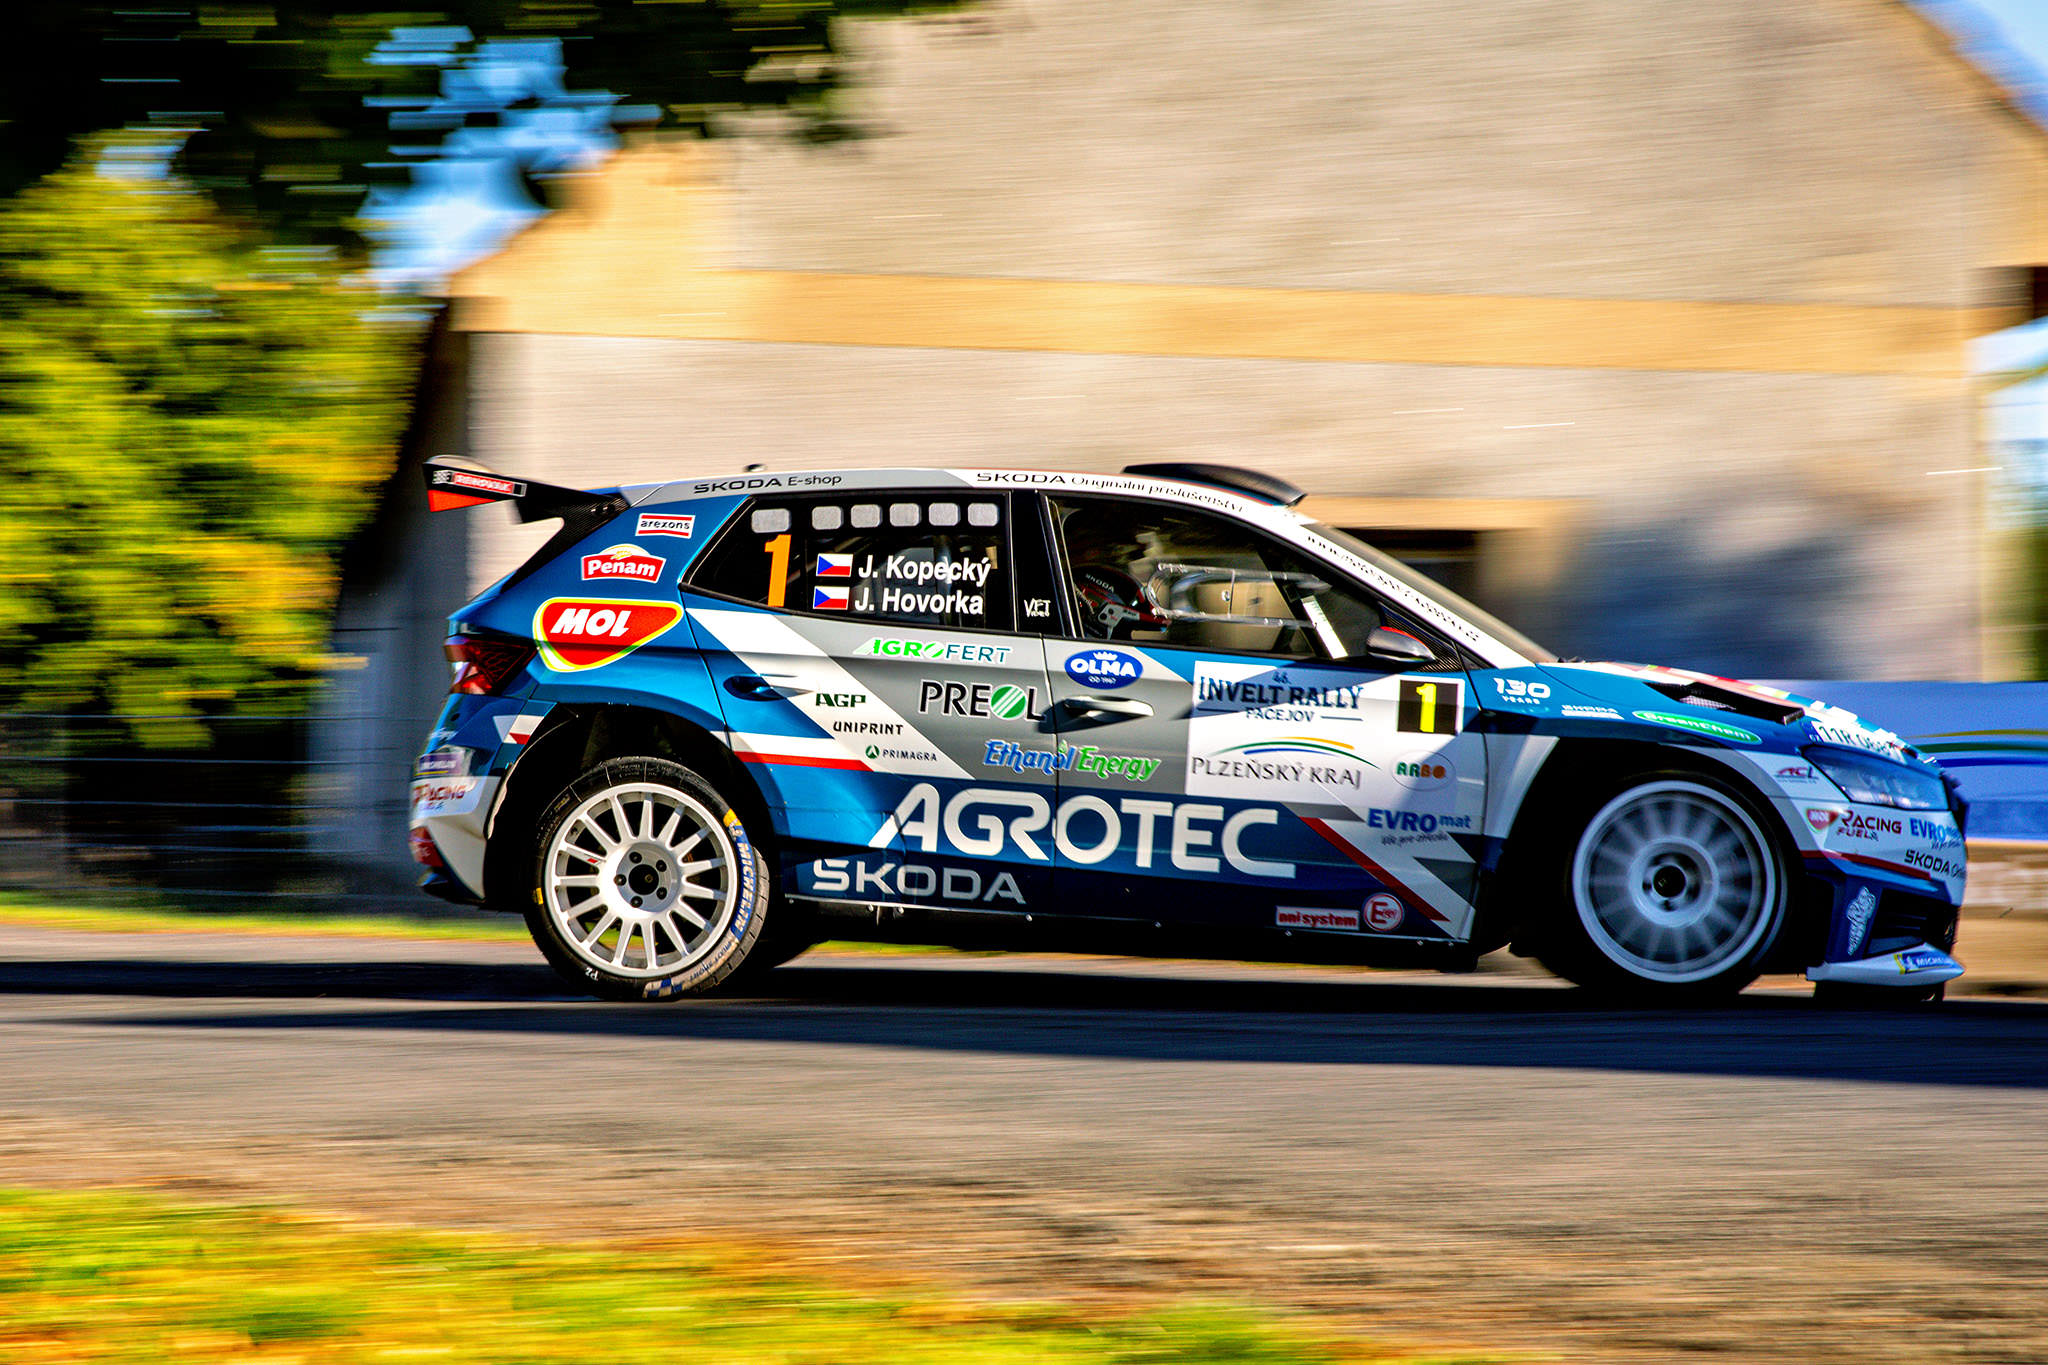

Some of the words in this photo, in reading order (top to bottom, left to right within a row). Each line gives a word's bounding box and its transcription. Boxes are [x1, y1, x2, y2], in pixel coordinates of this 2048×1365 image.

[788, 475, 842, 486] E-shop
[640, 520, 690, 530] arexons
[588, 560, 656, 577] Penam
[764, 534, 791, 608] 1
[858, 555, 878, 578] J.
[886, 555, 991, 587] Kopecký
[855, 587, 874, 611] J.
[882, 588, 984, 615] Hovorka
[550, 608, 632, 637] MOL
[1070, 658, 1137, 678] OLMA
[816, 693, 866, 708] AGP
[1199, 676, 1284, 704] INVELT
[1289, 686, 1364, 709] RALLY
[1493, 677, 1551, 699] 130
[1415, 683, 1437, 733] 1
[833, 721, 904, 735] UNIPRINT
[882, 749, 938, 762] PRIMAGRA
[984, 740, 1074, 775] Ethanol
[1076, 744, 1160, 781] Energy
[1310, 766, 1361, 791] KRAJ
[869, 783, 1295, 879] AGROTEC
[1842, 810, 1902, 834] RACING
[737, 842, 754, 932] MICHELIN
